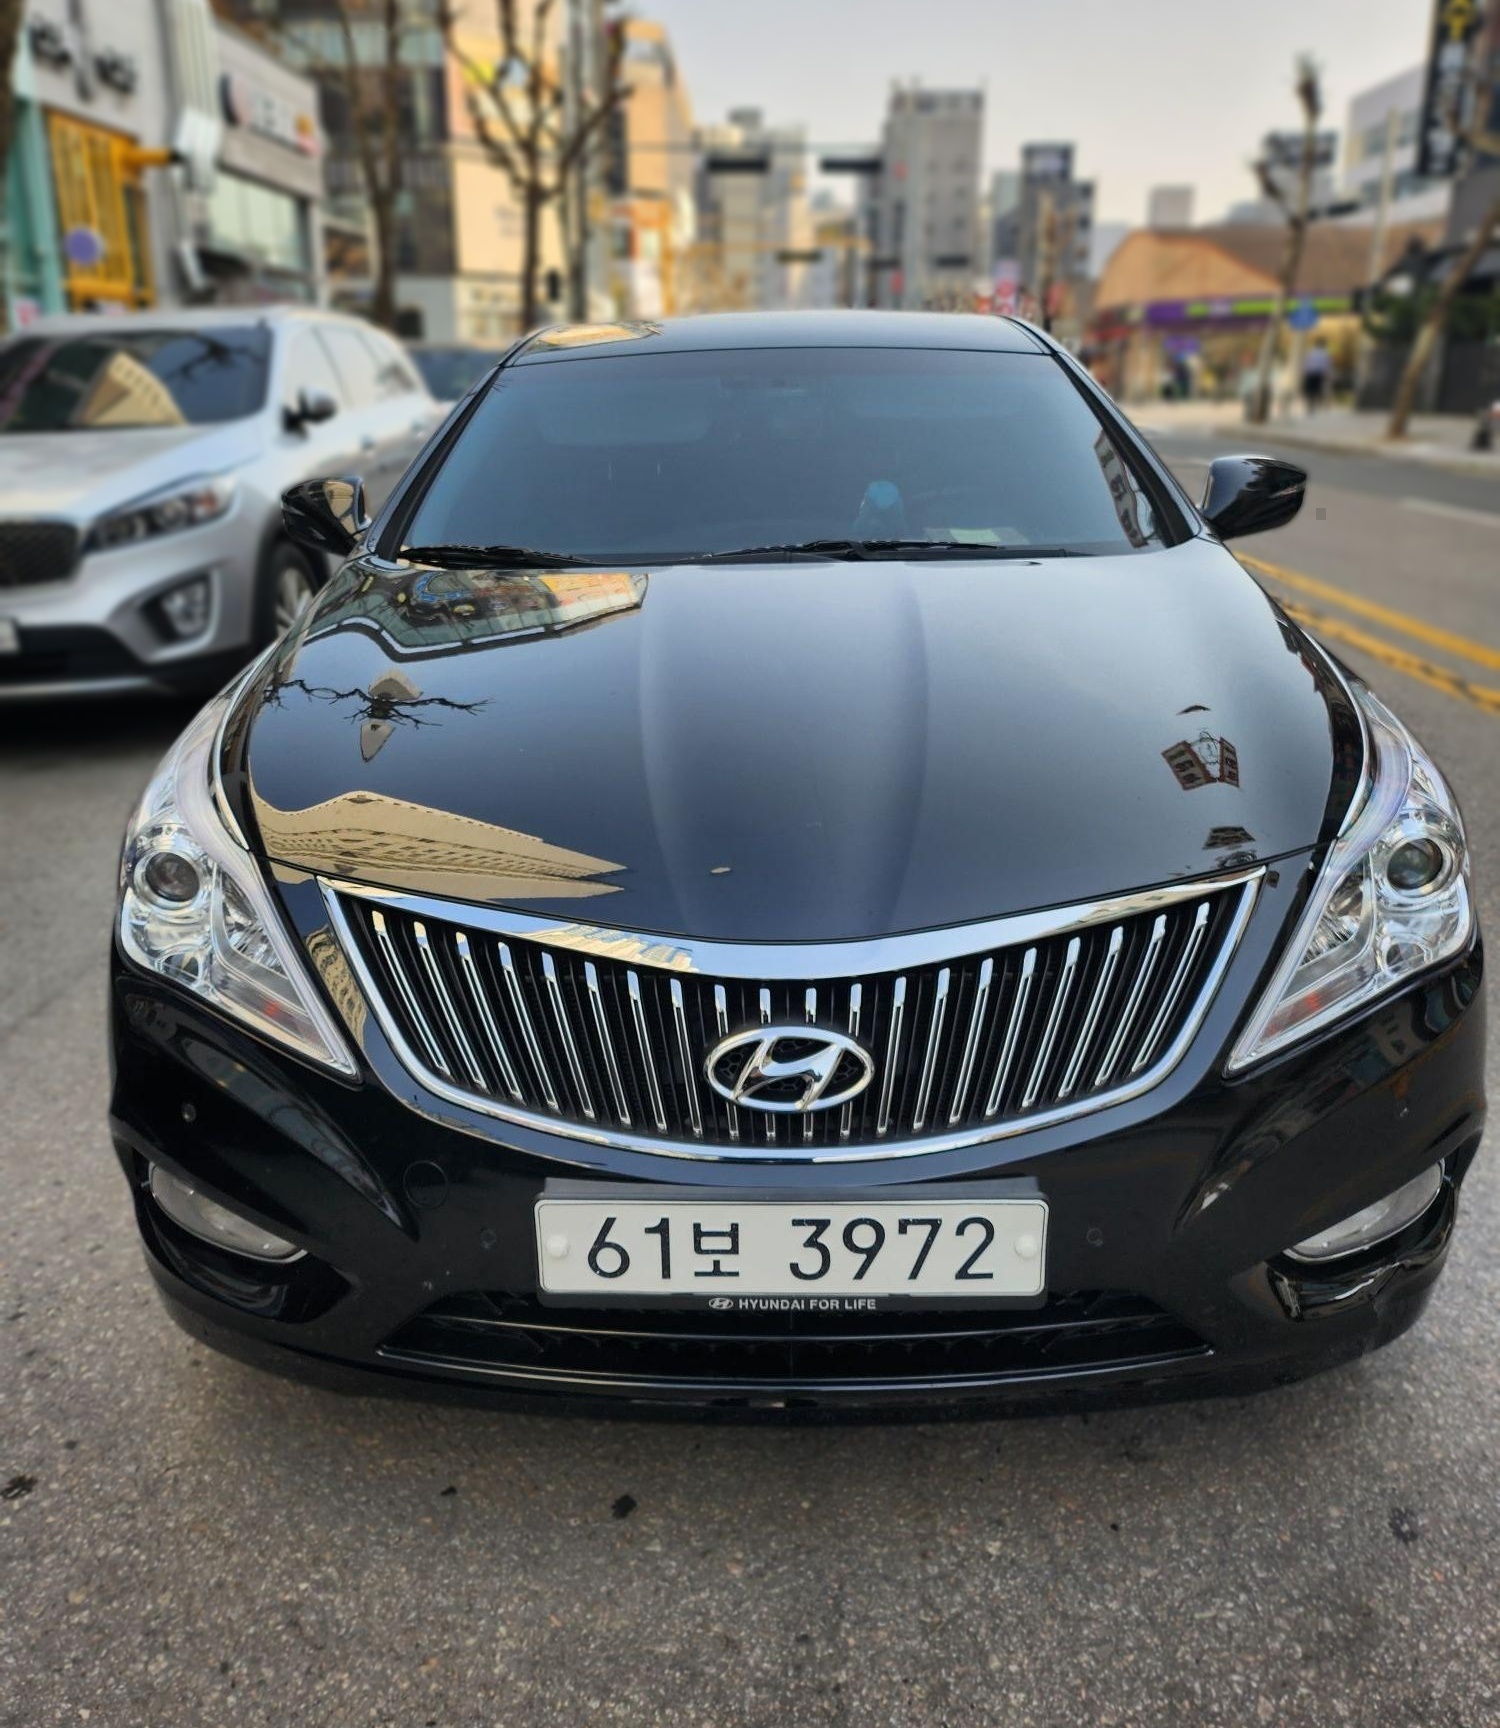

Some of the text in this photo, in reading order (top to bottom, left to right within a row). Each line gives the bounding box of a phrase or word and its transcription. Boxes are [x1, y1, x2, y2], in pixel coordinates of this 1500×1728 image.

[587, 1217, 995, 1281] 61보 3972
[738, 1298, 876, 1310] HYUNDAI FOR LIFE
